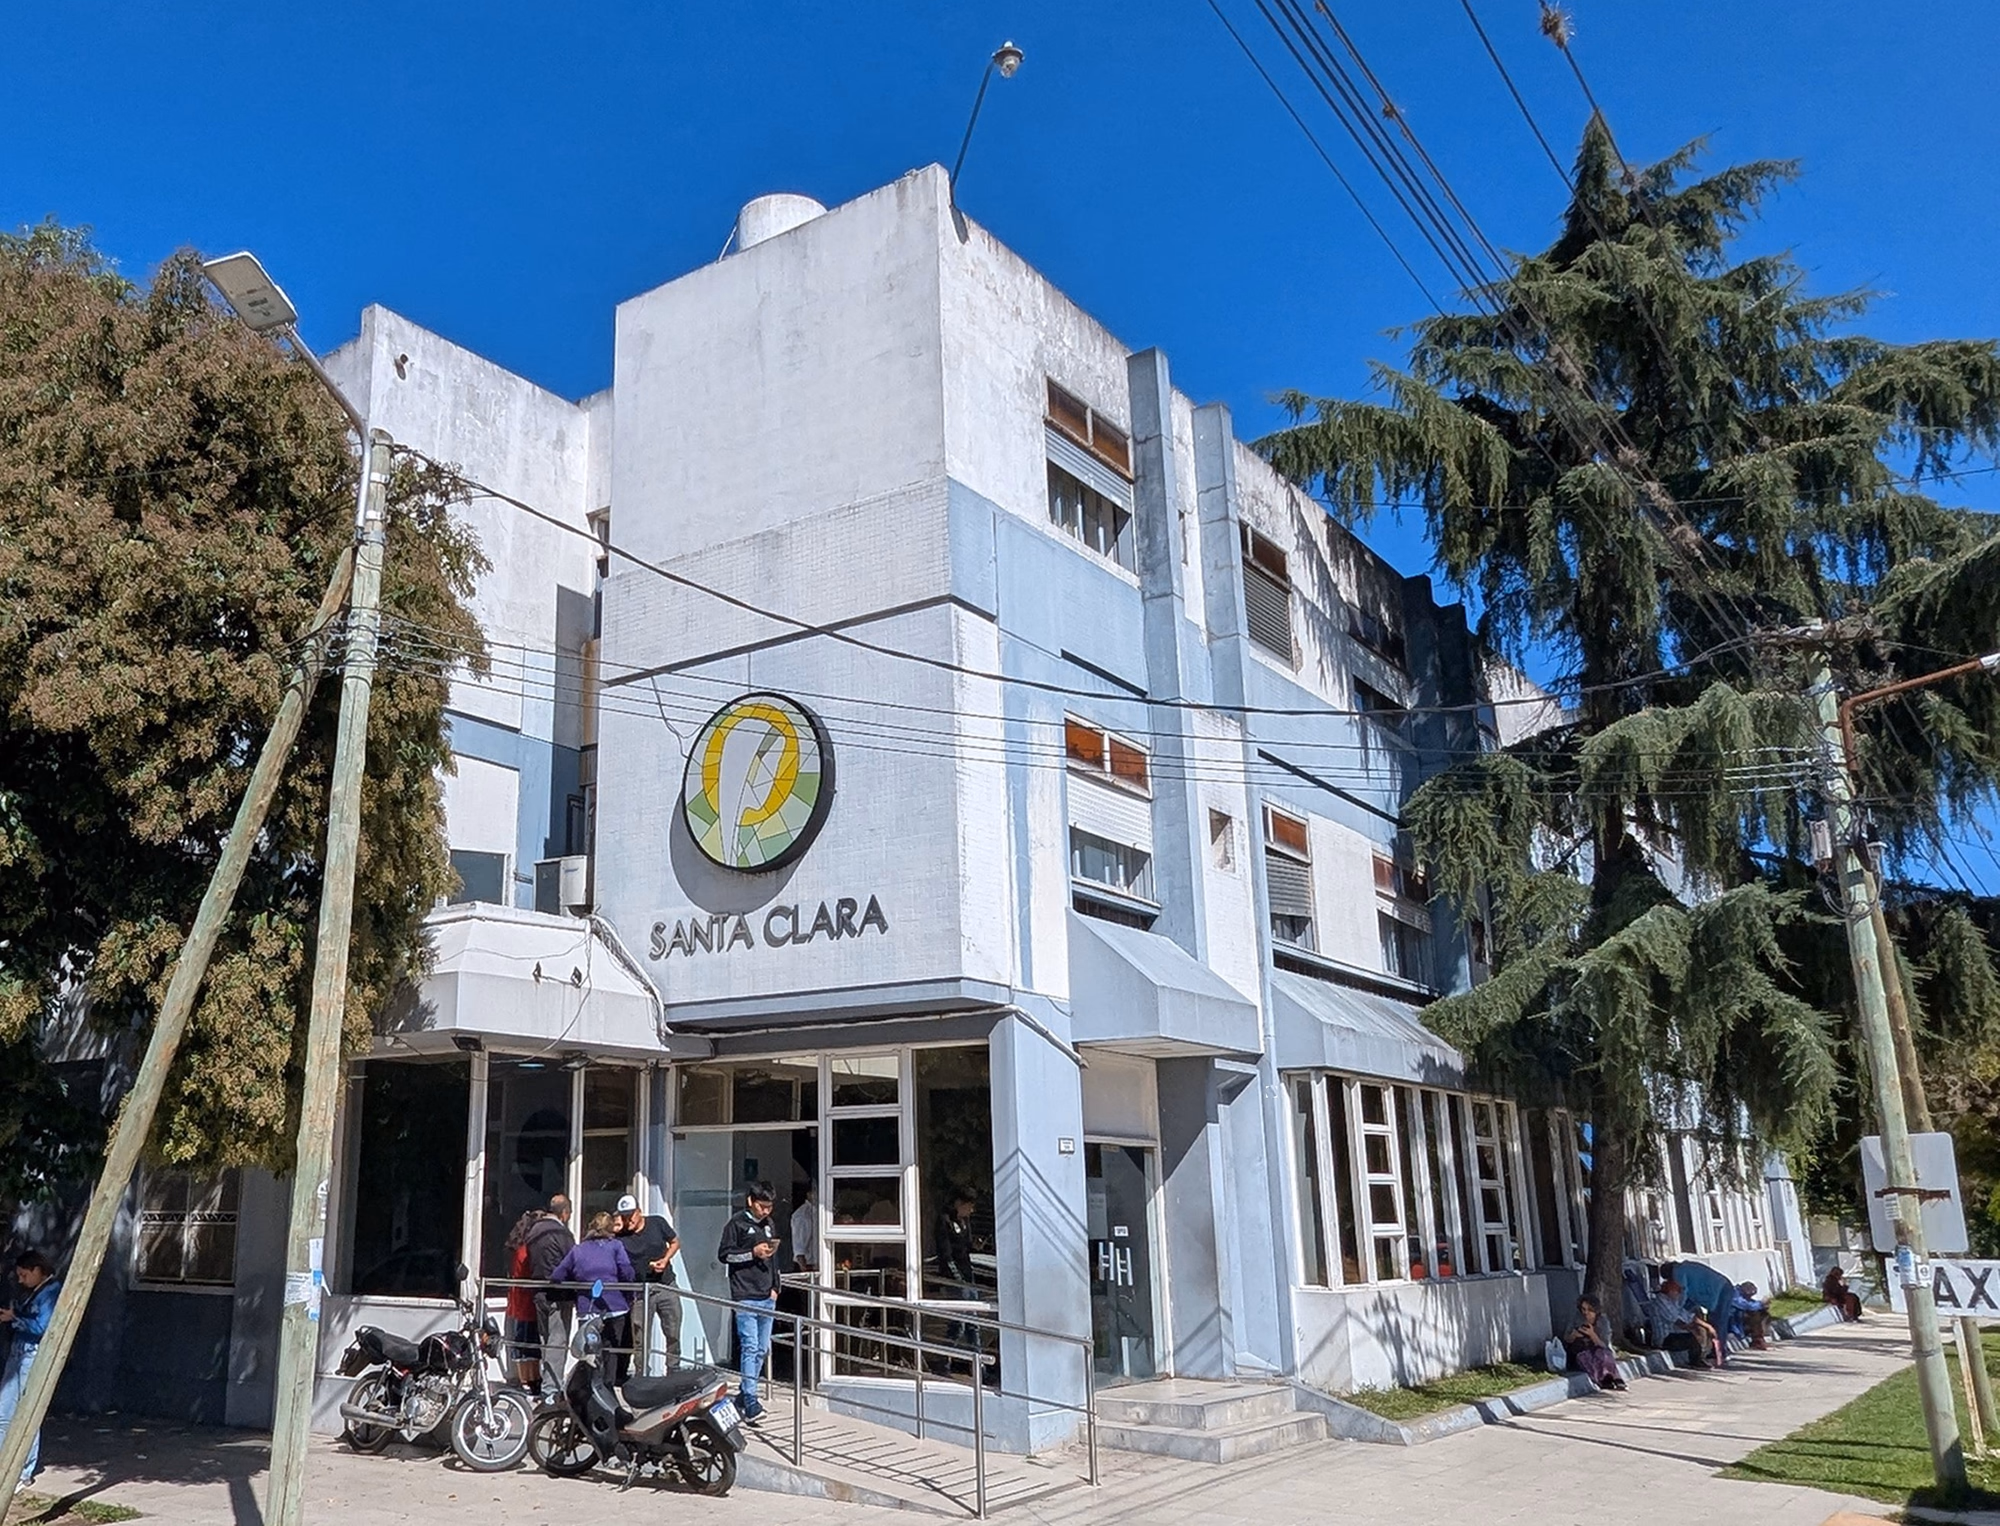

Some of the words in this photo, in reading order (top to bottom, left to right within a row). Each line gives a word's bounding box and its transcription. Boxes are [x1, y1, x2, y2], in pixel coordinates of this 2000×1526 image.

[649, 912, 754, 961] SANTA
[763, 894, 889, 948] CLARA
[1893, 1264, 2000, 1310] AX
